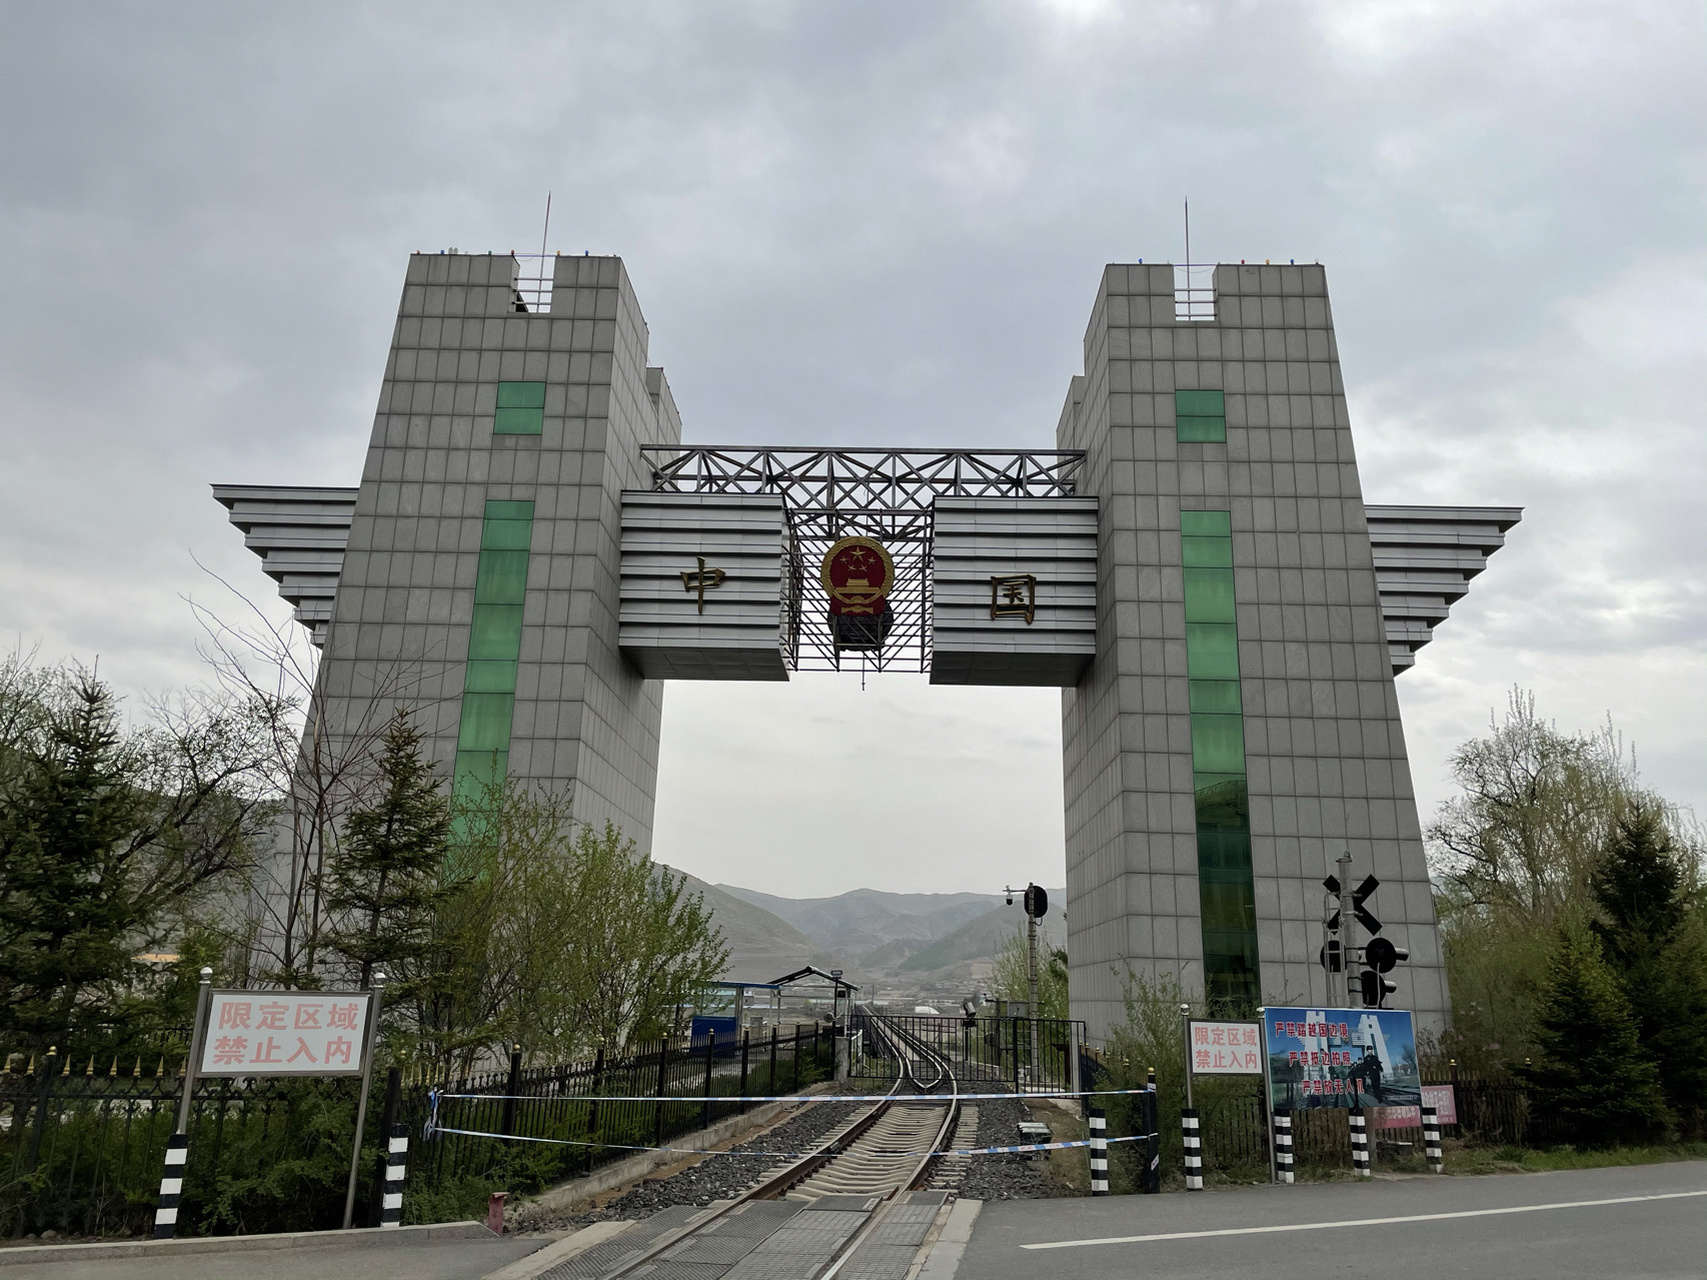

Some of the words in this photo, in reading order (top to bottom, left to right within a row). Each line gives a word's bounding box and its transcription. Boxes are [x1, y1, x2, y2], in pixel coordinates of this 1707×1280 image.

[680, 556, 726, 616] 中
[990, 573, 1037, 625] 国
[218, 1001, 359, 1031] 限定区域
[1194, 1026, 1257, 1047] 限定区域
[213, 1035, 353, 1066] 禁止入内
[1195, 1049, 1258, 1069] 禁止入内
[1289, 1051, 1352, 1067] 严禁抵边拍照
